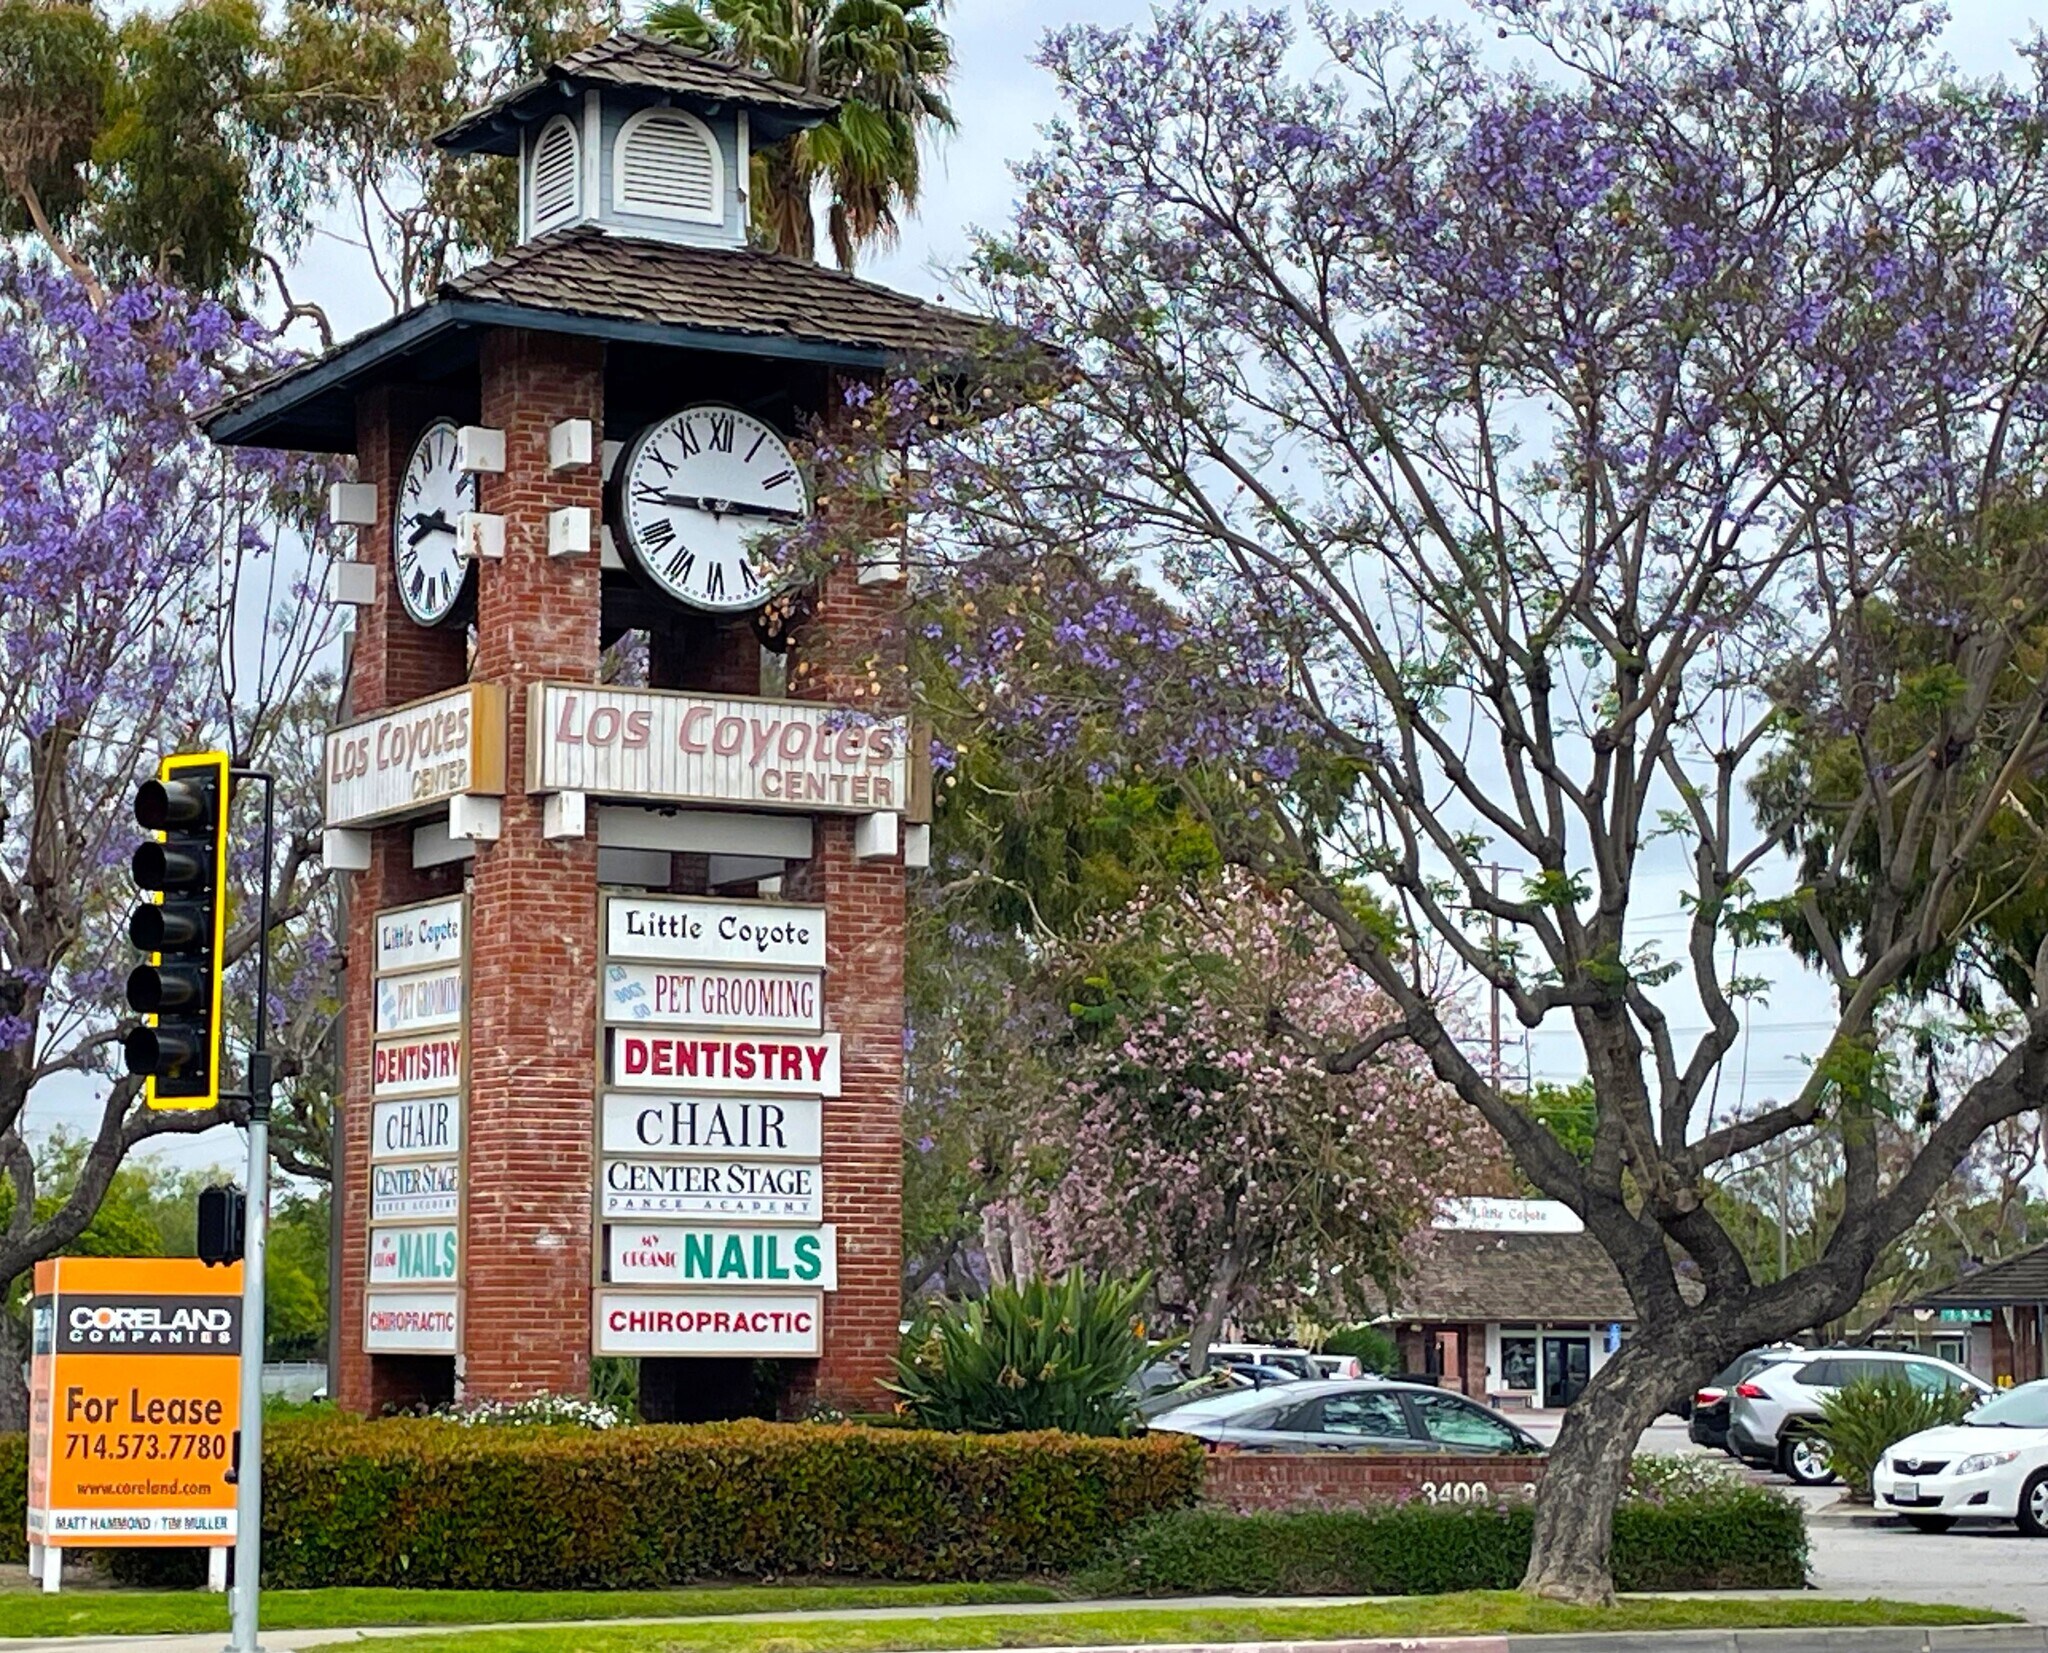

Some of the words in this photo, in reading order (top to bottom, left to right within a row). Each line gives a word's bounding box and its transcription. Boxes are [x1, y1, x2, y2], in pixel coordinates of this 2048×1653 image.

[332, 736, 369, 784] Los
[377, 707, 469, 772] Coyotes
[556, 697, 652, 748] Los
[679, 706, 894, 767] Coyotes
[412, 759, 467, 799] CENTER
[761, 768, 893, 805] CENTER
[626, 910, 702, 939] Little
[718, 916, 810, 952] Coyote
[655, 974, 695, 1013] PET
[702, 977, 814, 1018] GROOMING
[376, 1040, 460, 1084] DENTISTRY
[625, 1038, 828, 1081] DENTISTRY
[376, 1168, 421, 1196] CENTER
[607, 1161, 721, 1192] CENTER
[727, 1164, 812, 1195] STAGE
[609, 1198, 682, 1209] DANCE
[704, 1201, 809, 1212] ACADEMY
[397, 1231, 457, 1278] NAILS
[685, 1234, 821, 1281] NAILS
[69, 1306, 232, 1330] CORELAND
[370, 1312, 455, 1333] CHIROPRACTIC
[609, 1311, 812, 1333] CHIROPRACTIC
[69, 1330, 231, 1343] COMPANIES
[67, 1387, 119, 1423] For
[131, 1388, 222, 1425] Lease
[65, 1434, 226, 1460] 714.573.7780
[77, 1478, 211, 1495] www.coreland.com
[1421, 1482, 1487, 1505] 3400
[56, 1516, 88, 1531] MATT
[90, 1517, 150, 1531] HAMMOND
